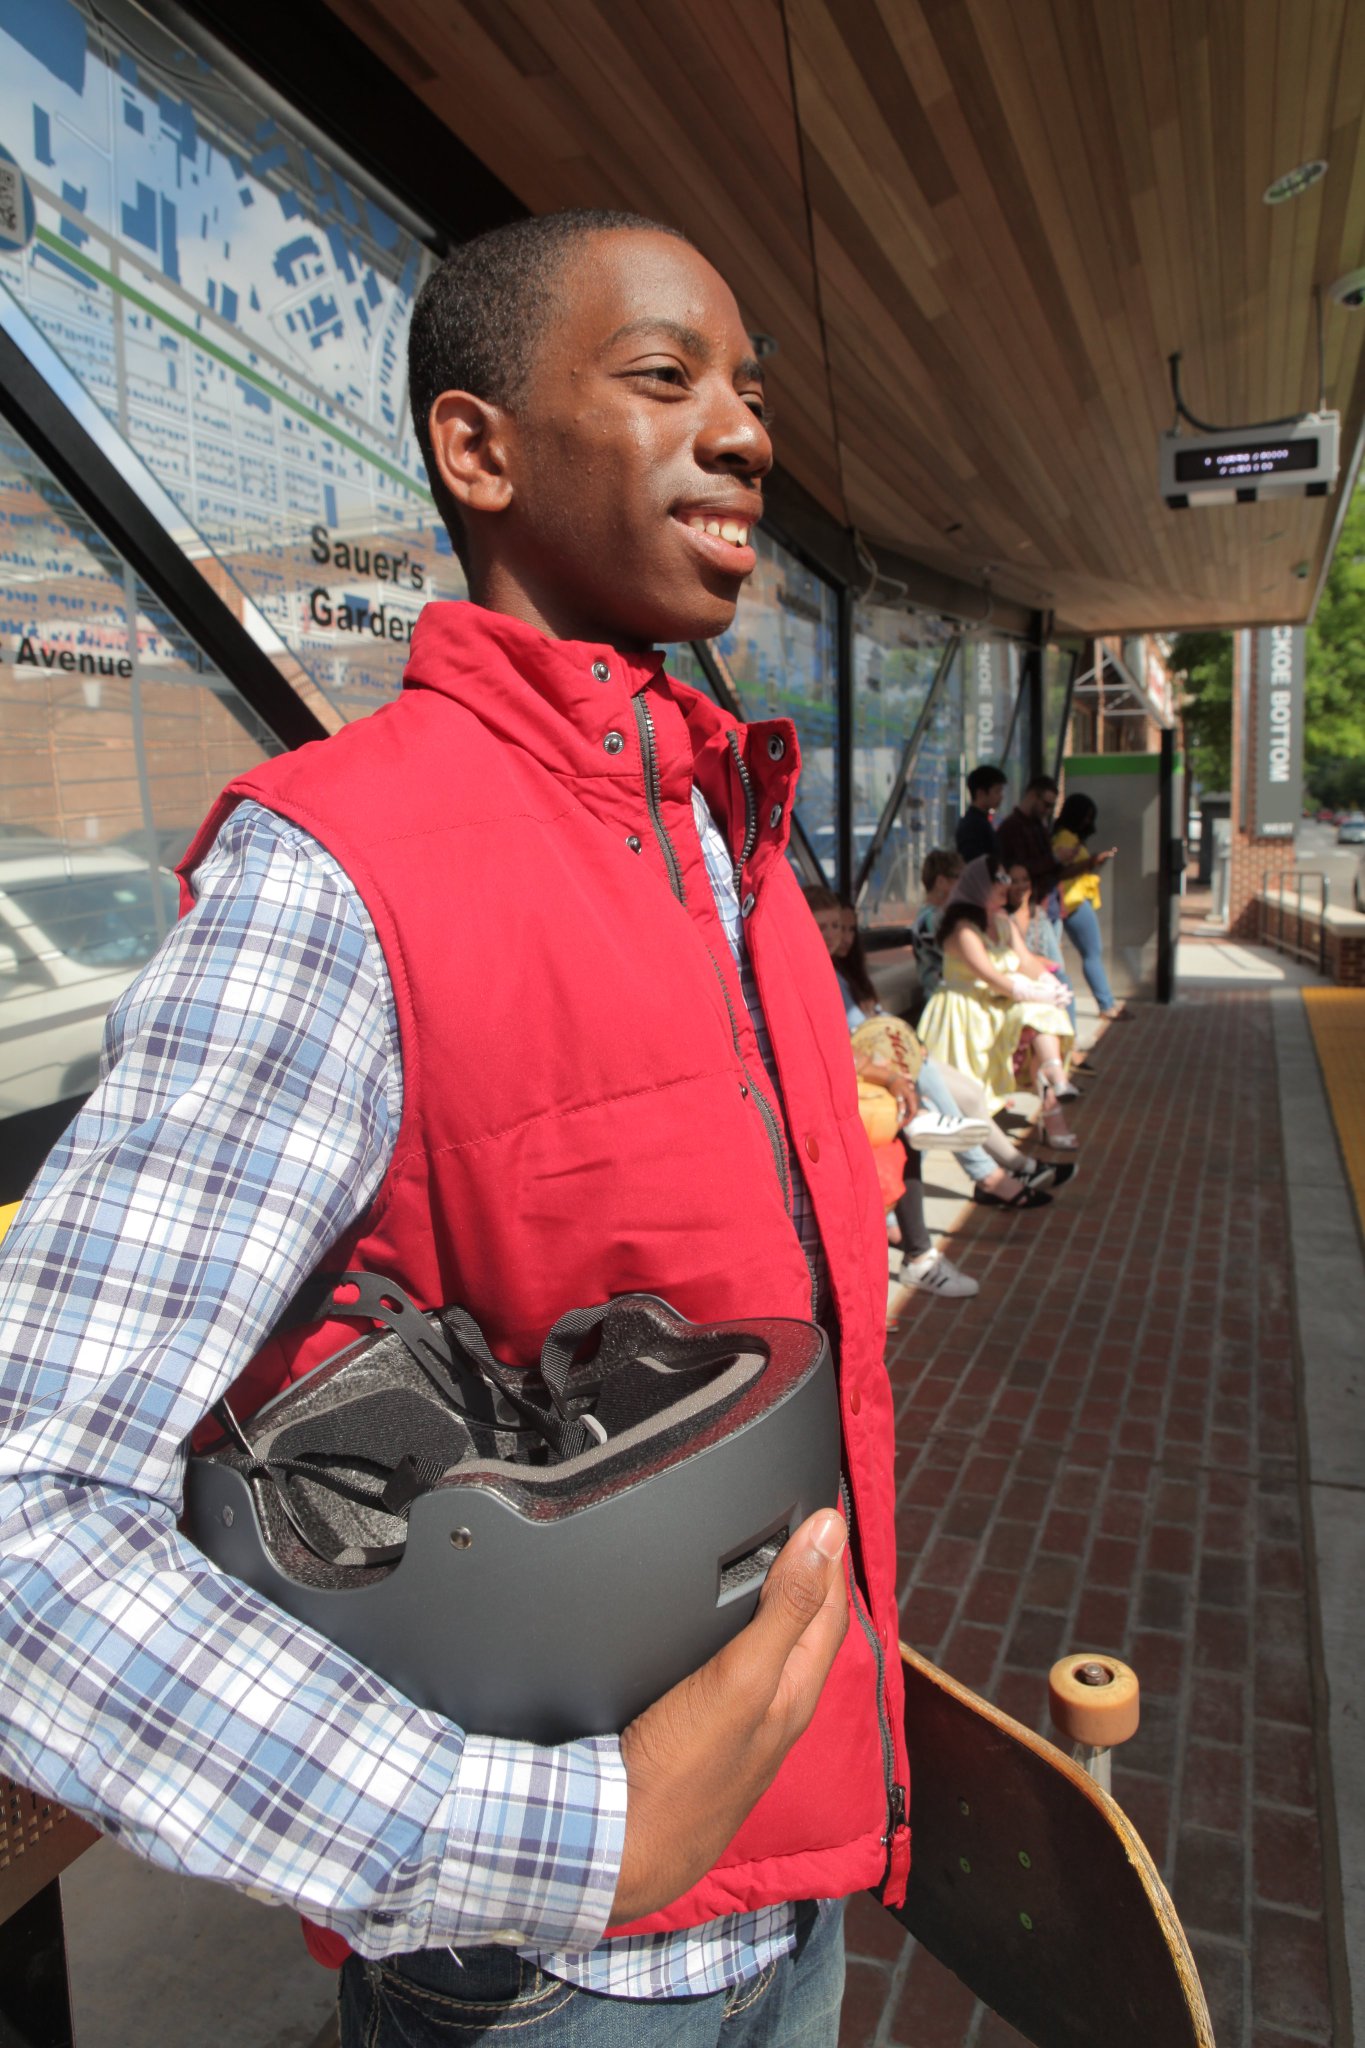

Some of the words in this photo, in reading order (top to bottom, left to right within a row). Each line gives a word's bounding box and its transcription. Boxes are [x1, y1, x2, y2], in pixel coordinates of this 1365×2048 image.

[310, 524, 424, 590] Sauer's
[15, 637, 133, 678] Avenue
[1268, 690, 1291, 782] BOTTOM
